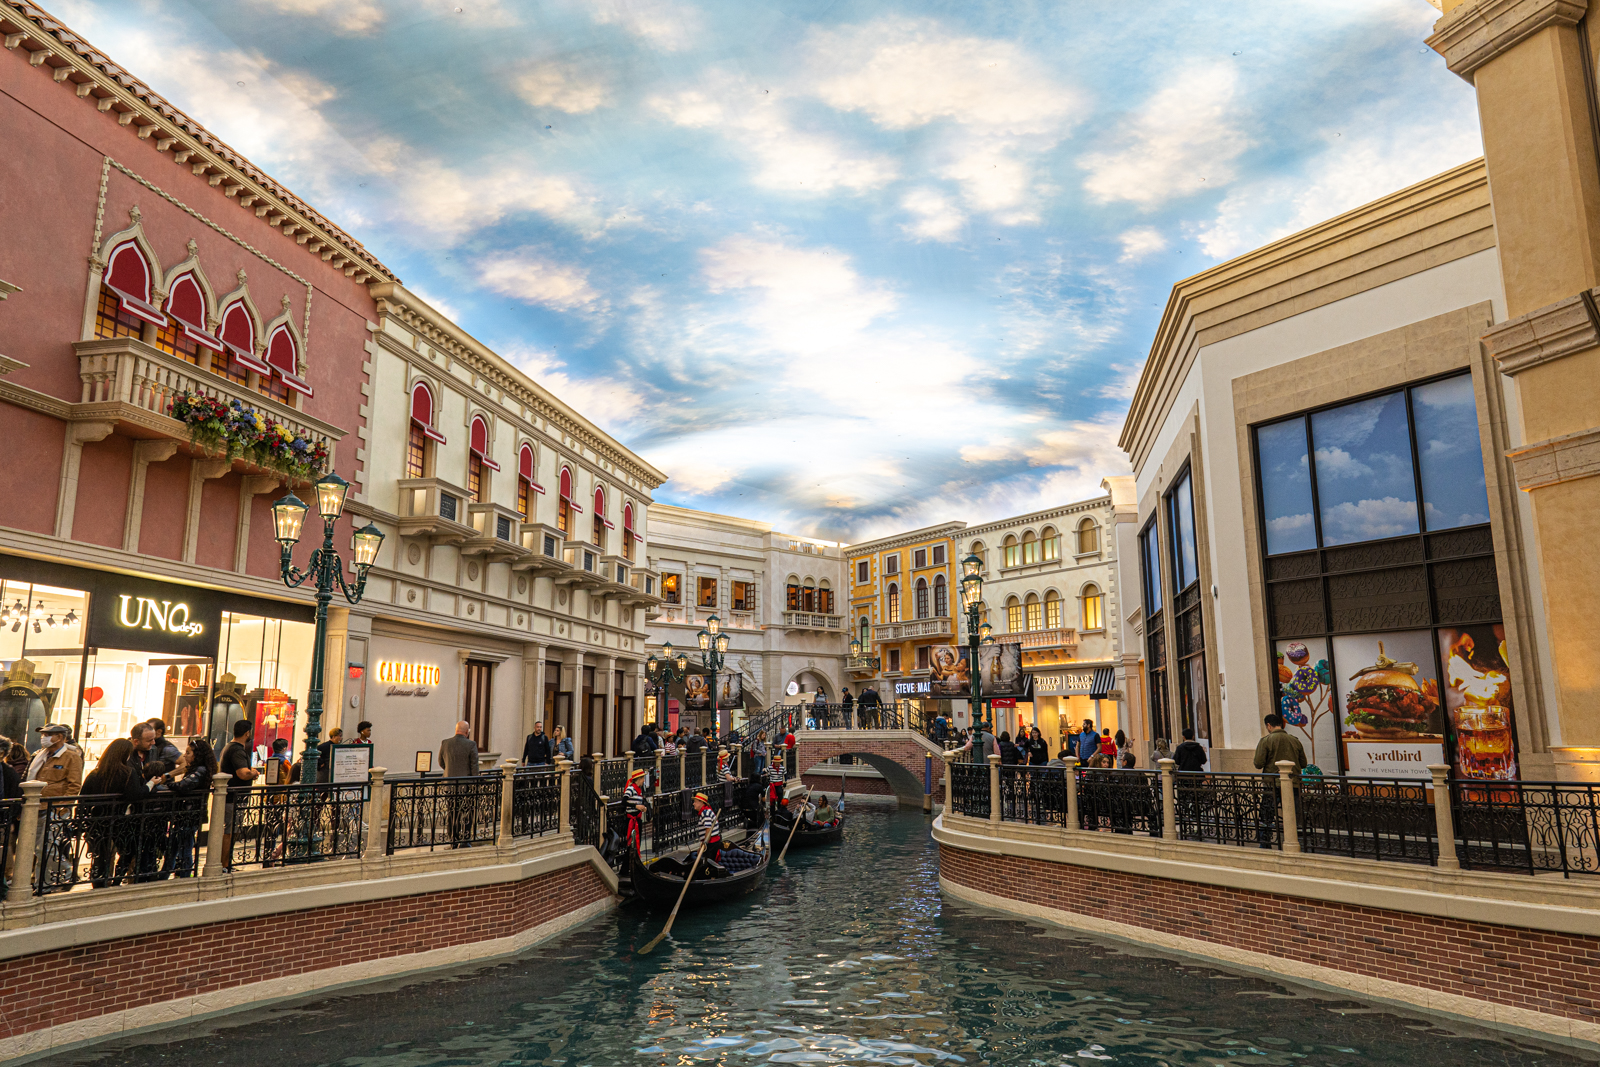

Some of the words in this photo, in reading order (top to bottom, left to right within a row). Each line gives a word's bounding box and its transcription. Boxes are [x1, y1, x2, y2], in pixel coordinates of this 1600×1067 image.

[119, 594, 189, 633] UNO
[380, 661, 441, 686] CANALETTO
[1066, 674, 1094, 685] BLACK
[1033, 675, 1060, 685] WHITE
[895, 682, 915, 694] STEVE
[1367, 750, 1422, 763] yardbird
[705, 866, 711, 876] 6
